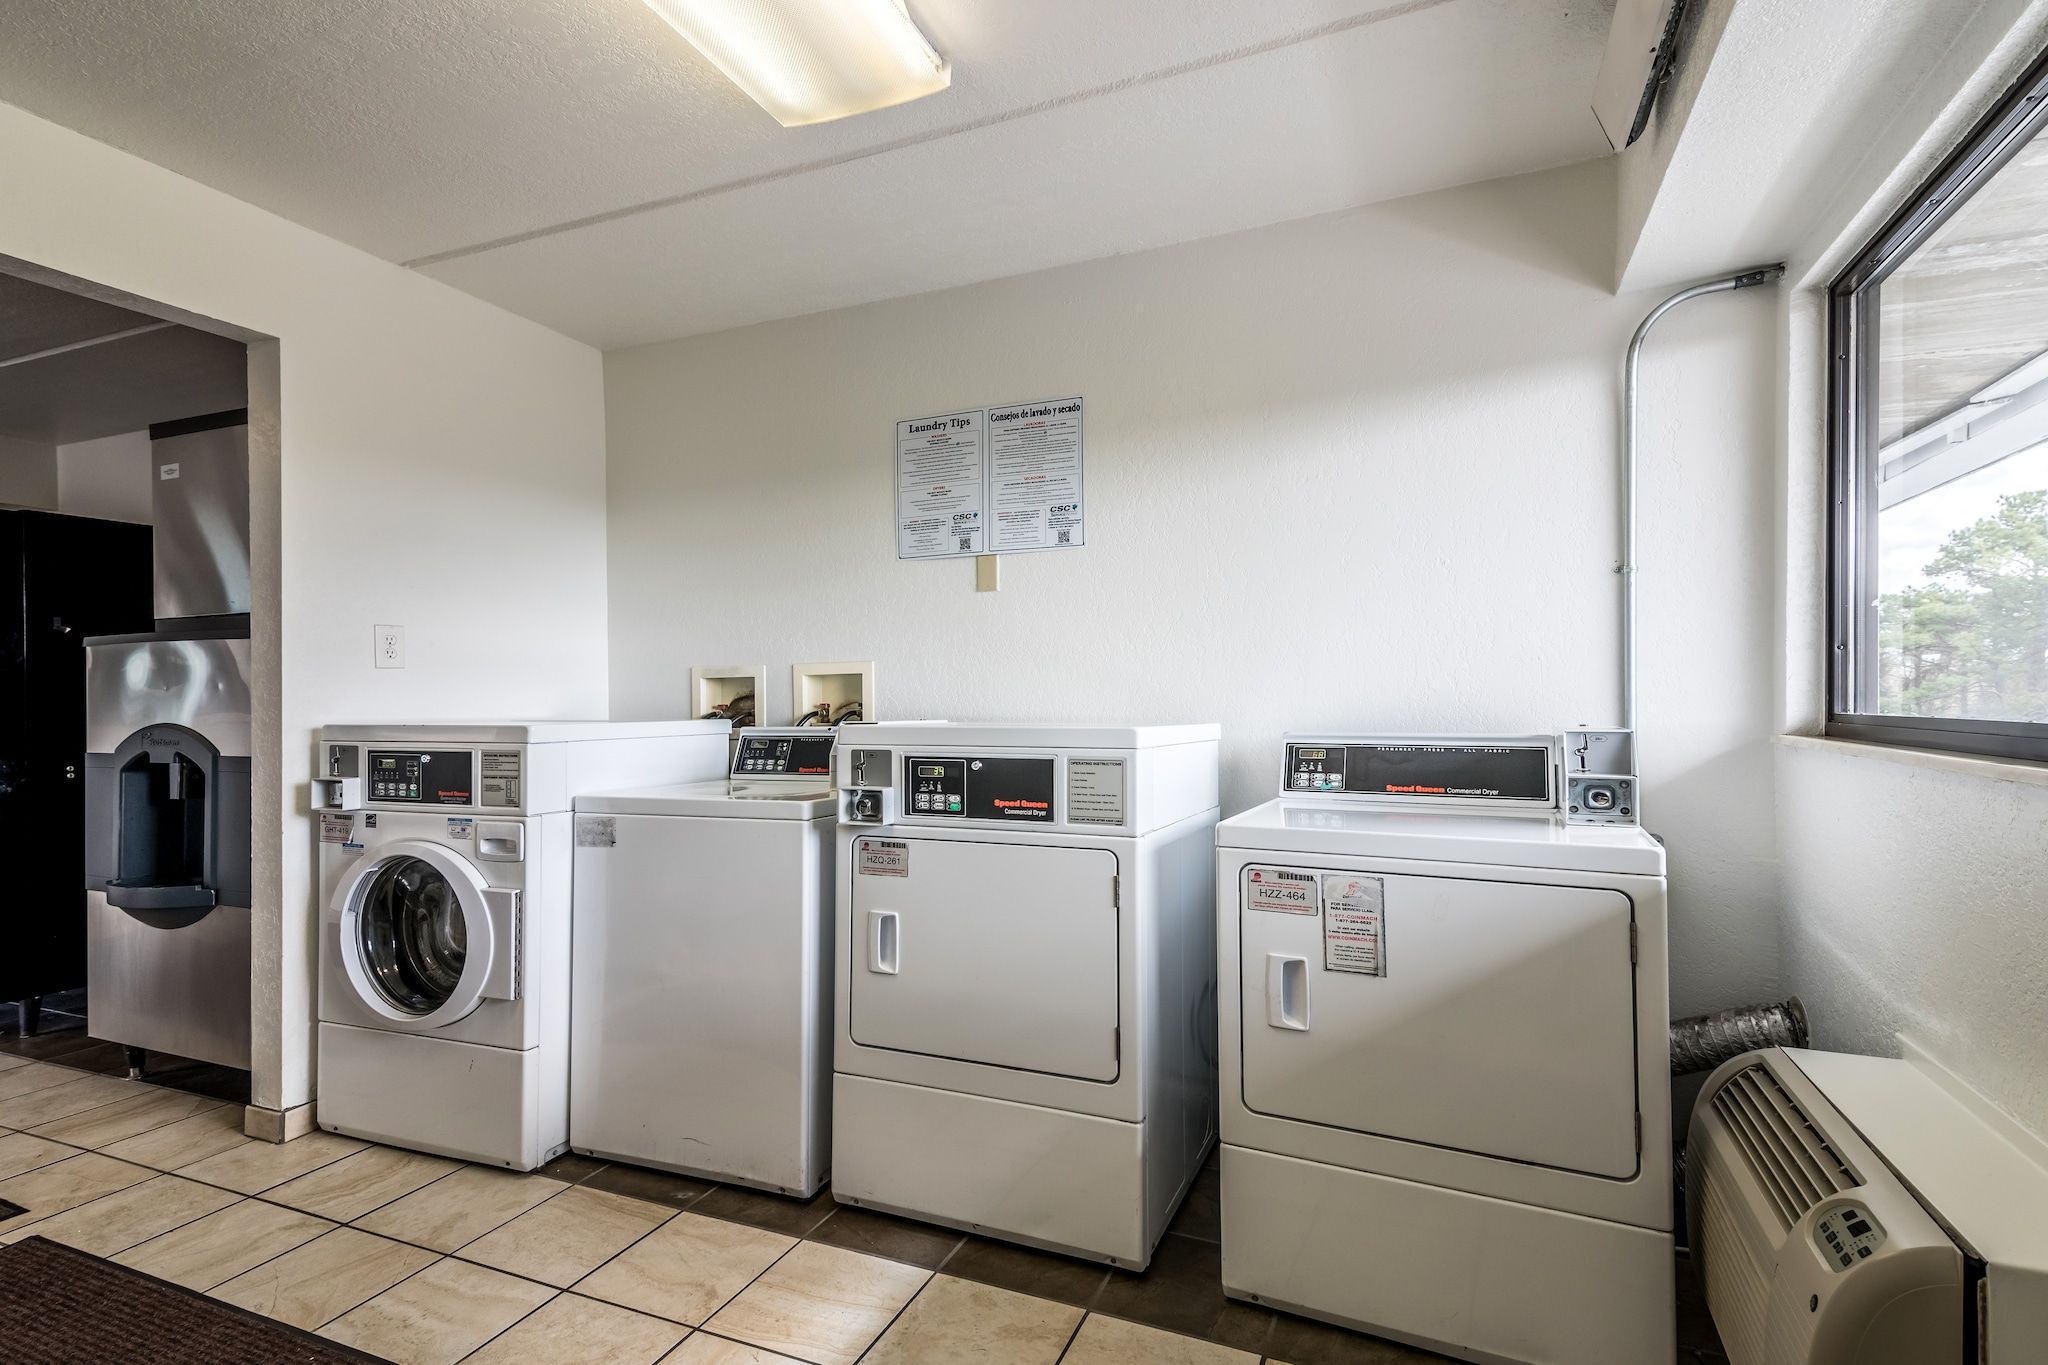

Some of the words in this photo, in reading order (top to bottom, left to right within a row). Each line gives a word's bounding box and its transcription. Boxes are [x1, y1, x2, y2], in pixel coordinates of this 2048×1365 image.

[990, 411, 1020, 422] Consejos
[1020, 409, 1028, 418] de
[1030, 406, 1052, 418] lavado
[1052, 407, 1057, 416] y
[1058, 403, 1080, 414] secado
[909, 420, 948, 434] Laundry
[950, 418, 971, 429] Tips
[1050, 504, 1071, 513] CSC
[1415, 785, 1445, 793] Queen
[994, 799, 1020, 807] Speed
[1021, 800, 1048, 808] Queen
[866, 856, 900, 865] HZQ-261
[1259, 888, 1306, 901] HZZ-464
